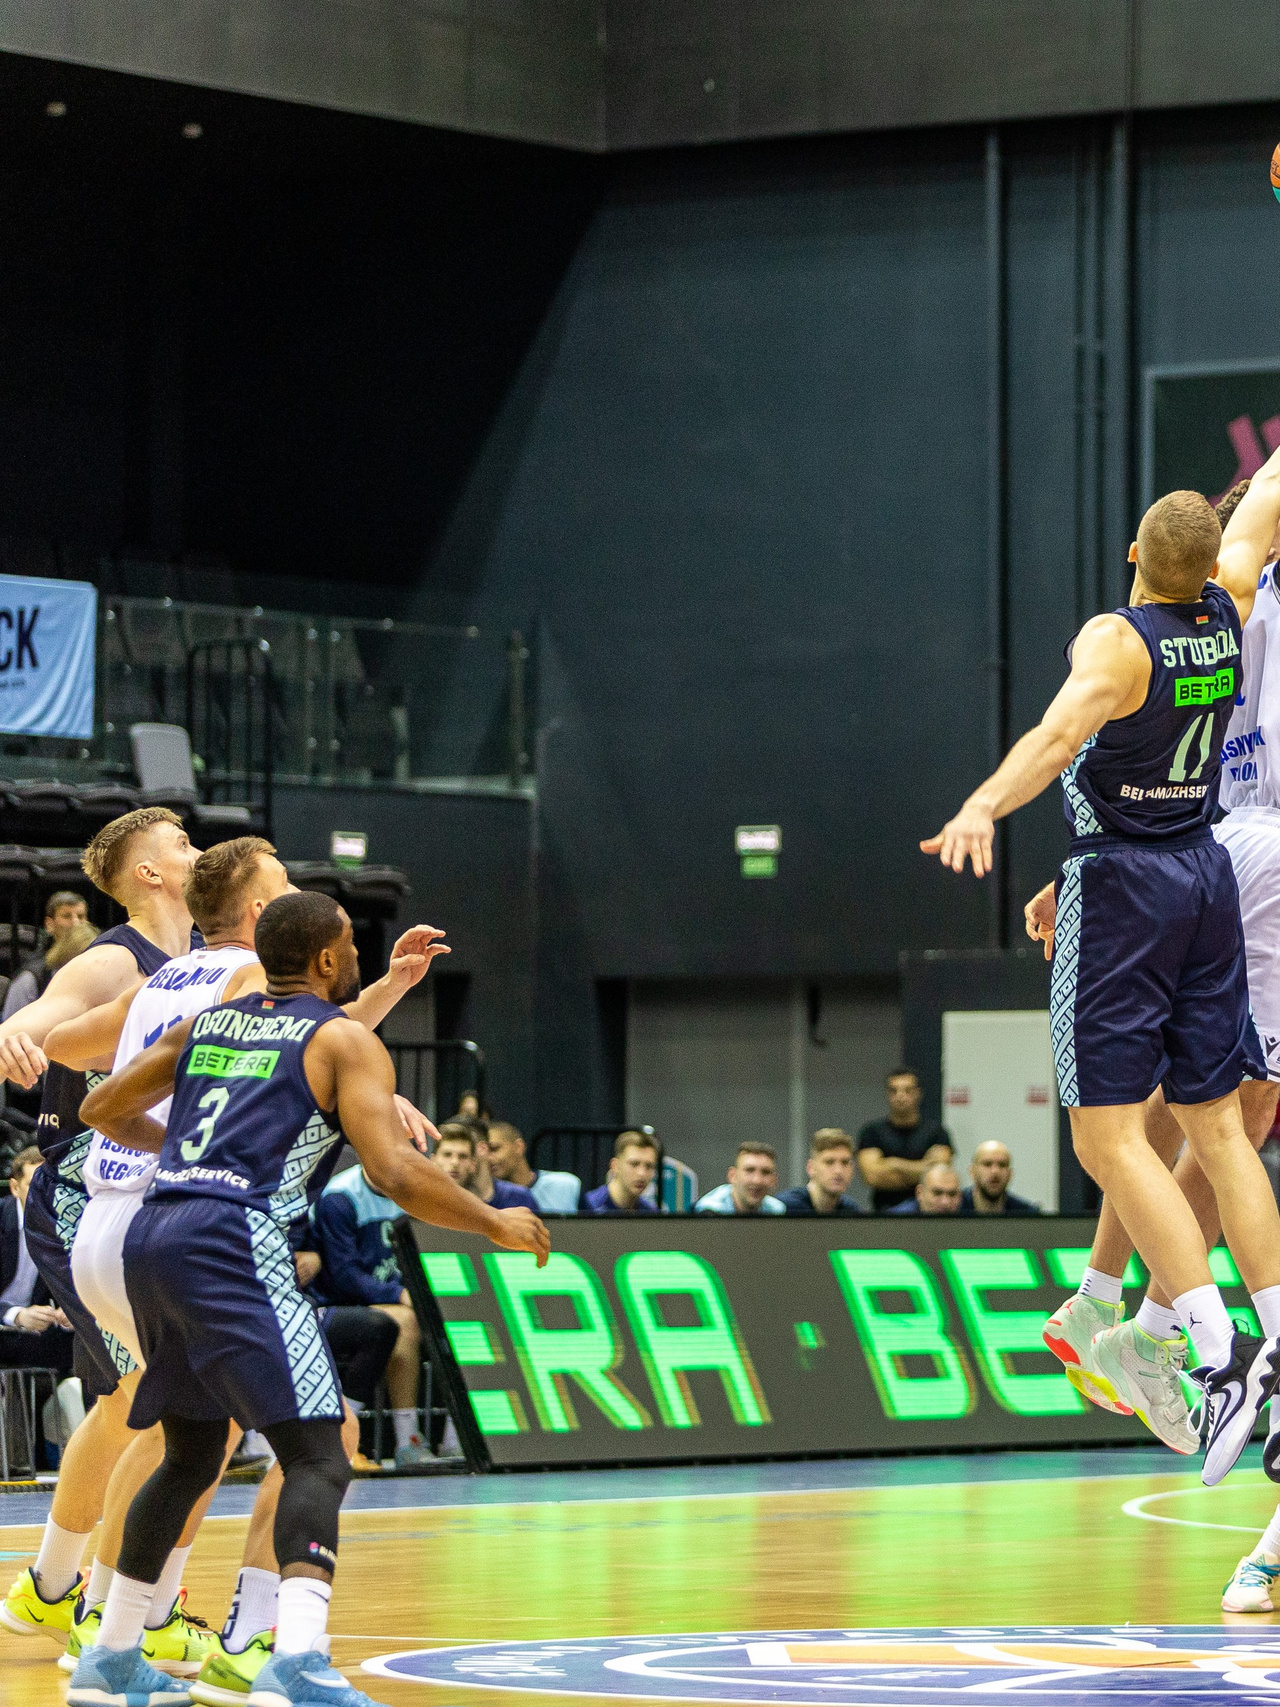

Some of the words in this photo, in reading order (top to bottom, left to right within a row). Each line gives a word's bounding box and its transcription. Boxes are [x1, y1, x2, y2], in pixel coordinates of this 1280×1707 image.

[192, 1008, 317, 1042] OGUNGBEMI
[193, 1051, 272, 1072] BET.ERA
[180, 1086, 231, 1162] 3
